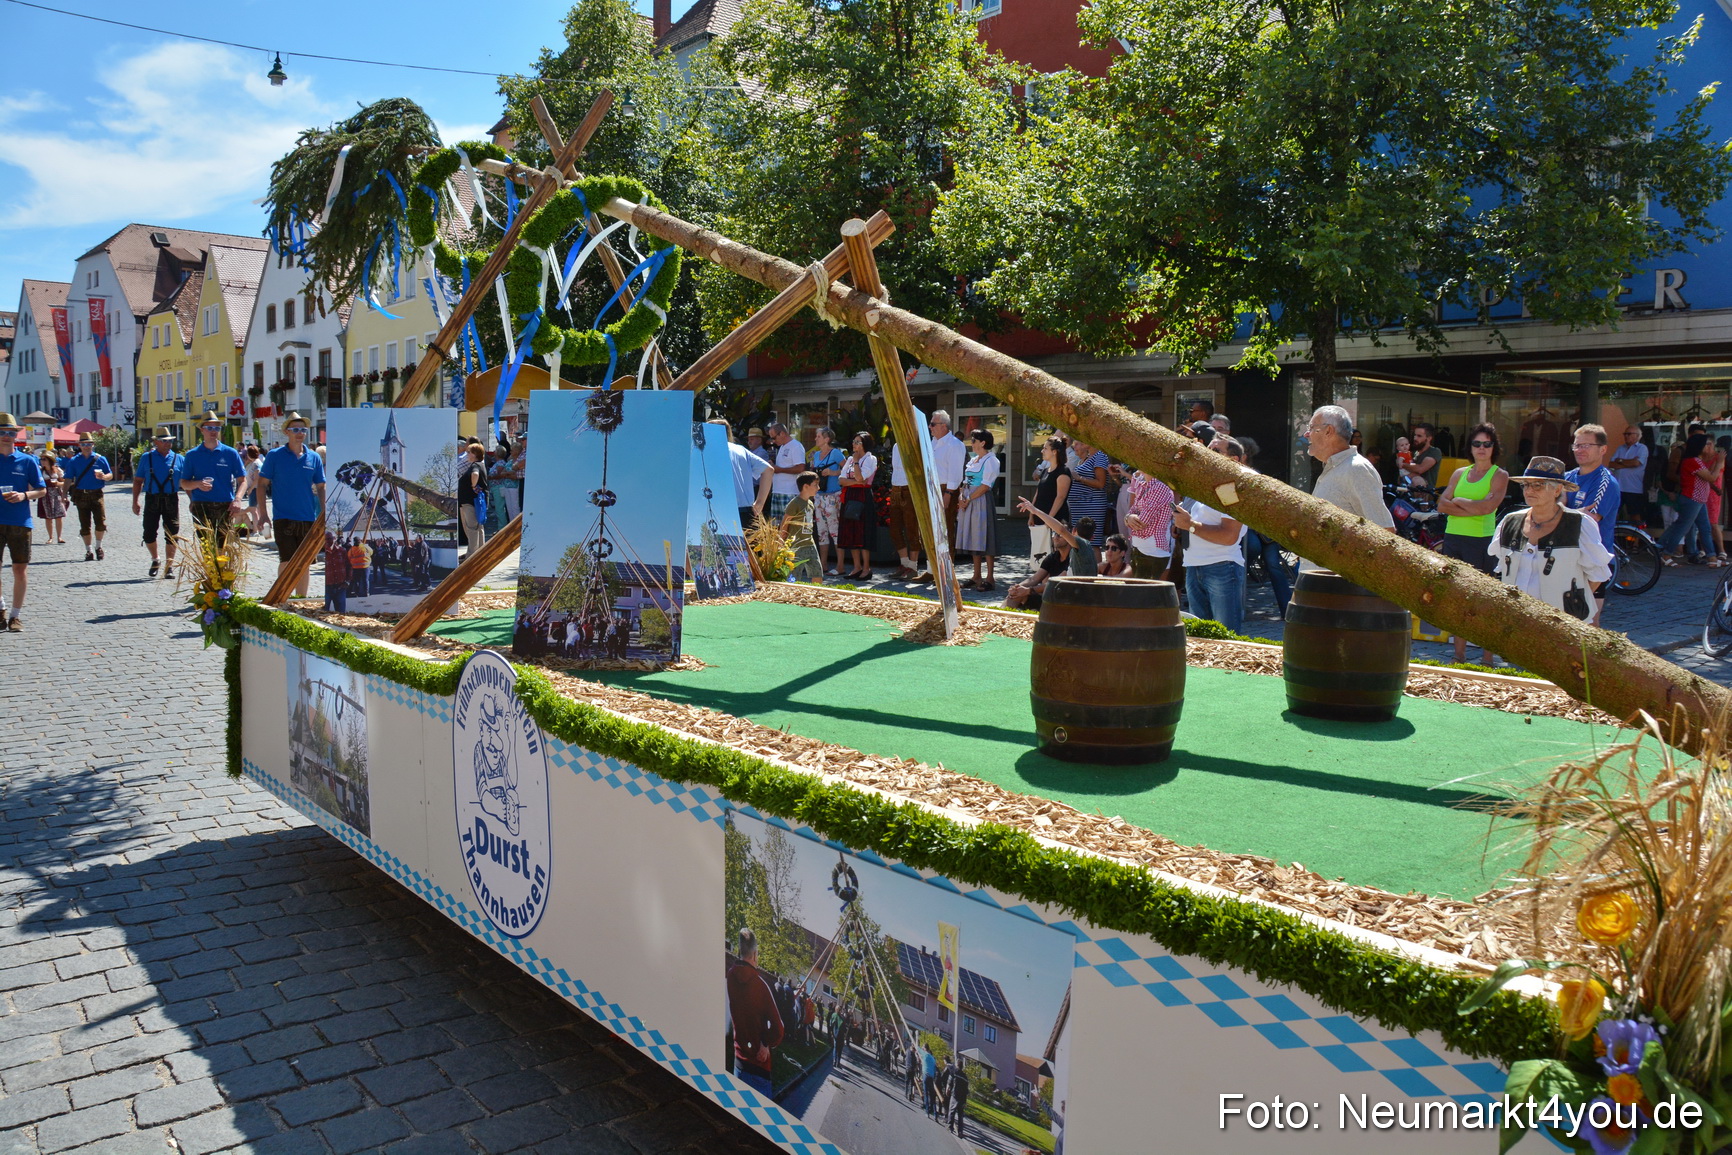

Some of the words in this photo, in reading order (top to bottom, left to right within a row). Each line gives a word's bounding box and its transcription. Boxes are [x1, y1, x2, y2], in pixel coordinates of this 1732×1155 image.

[159, 360, 172, 370] HOTEL
[462, 827, 546, 929] Thannhausen
[475, 816, 531, 880] Durst
